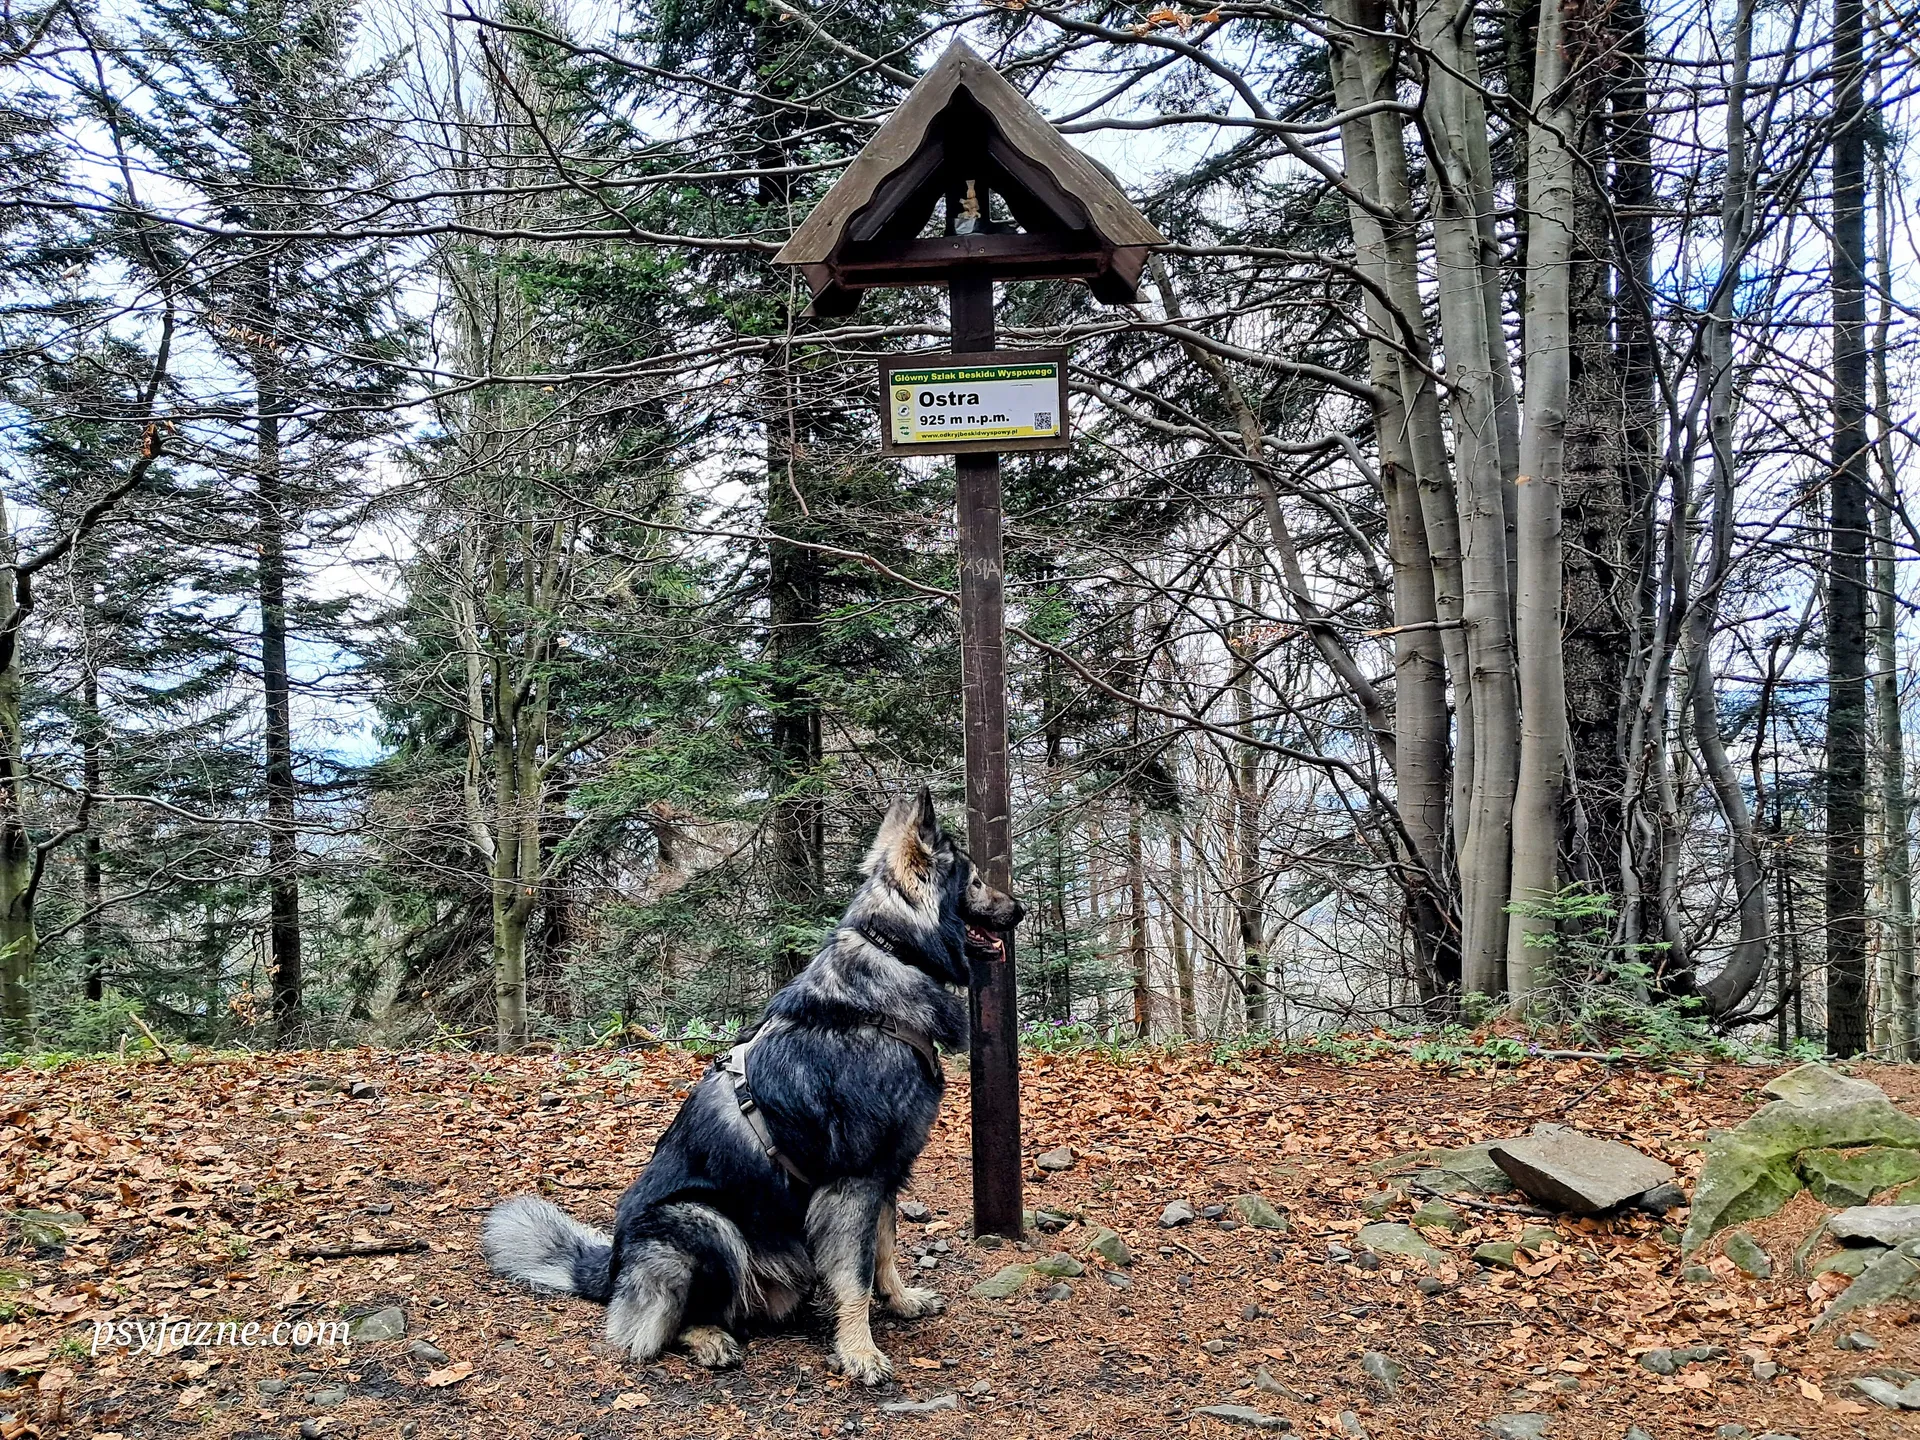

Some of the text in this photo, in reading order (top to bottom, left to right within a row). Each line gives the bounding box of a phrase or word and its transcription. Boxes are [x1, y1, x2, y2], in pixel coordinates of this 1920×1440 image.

[931, 372, 956, 380] Szlak
[958, 370, 995, 379] Beskidu
[997, 368, 1052, 378] Wyspowego
[919, 391, 980, 408] Ostra
[920, 415, 946, 426] 925
[950, 416, 963, 425] m
[967, 414, 1010, 426] n.p.m.
[921, 429, 1018, 439] www.odkryjbeskidwyspowy.pl
